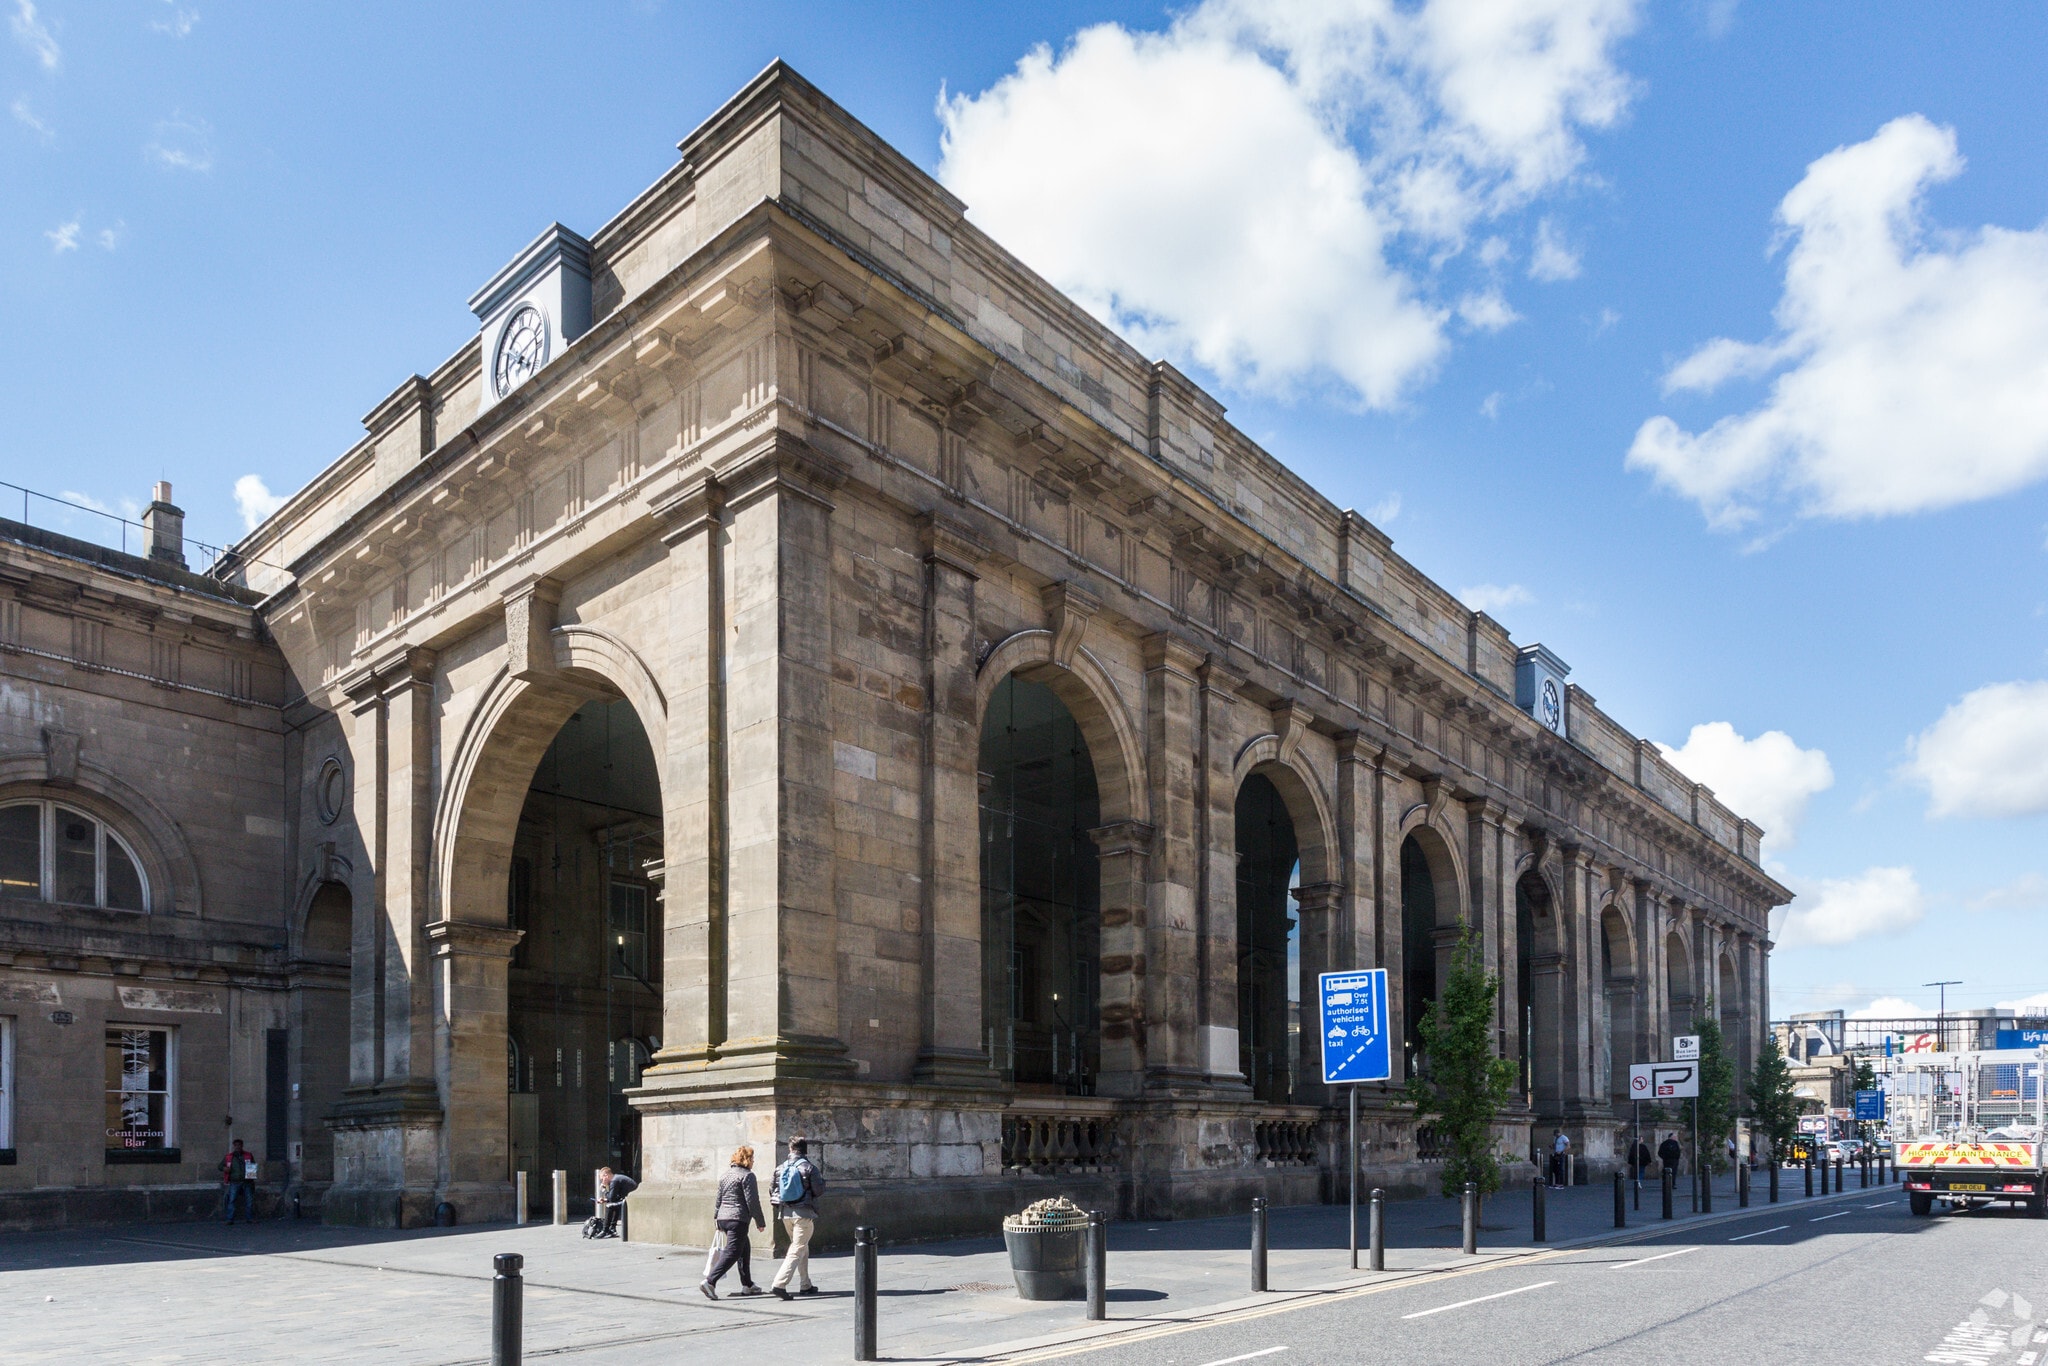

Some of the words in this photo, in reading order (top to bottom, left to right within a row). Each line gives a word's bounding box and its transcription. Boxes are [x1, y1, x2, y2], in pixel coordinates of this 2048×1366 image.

[1327, 1006, 1369, 1015] authorised
[1332, 1015, 1364, 1023] vehicles
[2023, 1032, 2041, 1042] Life
[105, 1128, 164, 1137] Centurion
[125, 1138, 146, 1148] Bar
